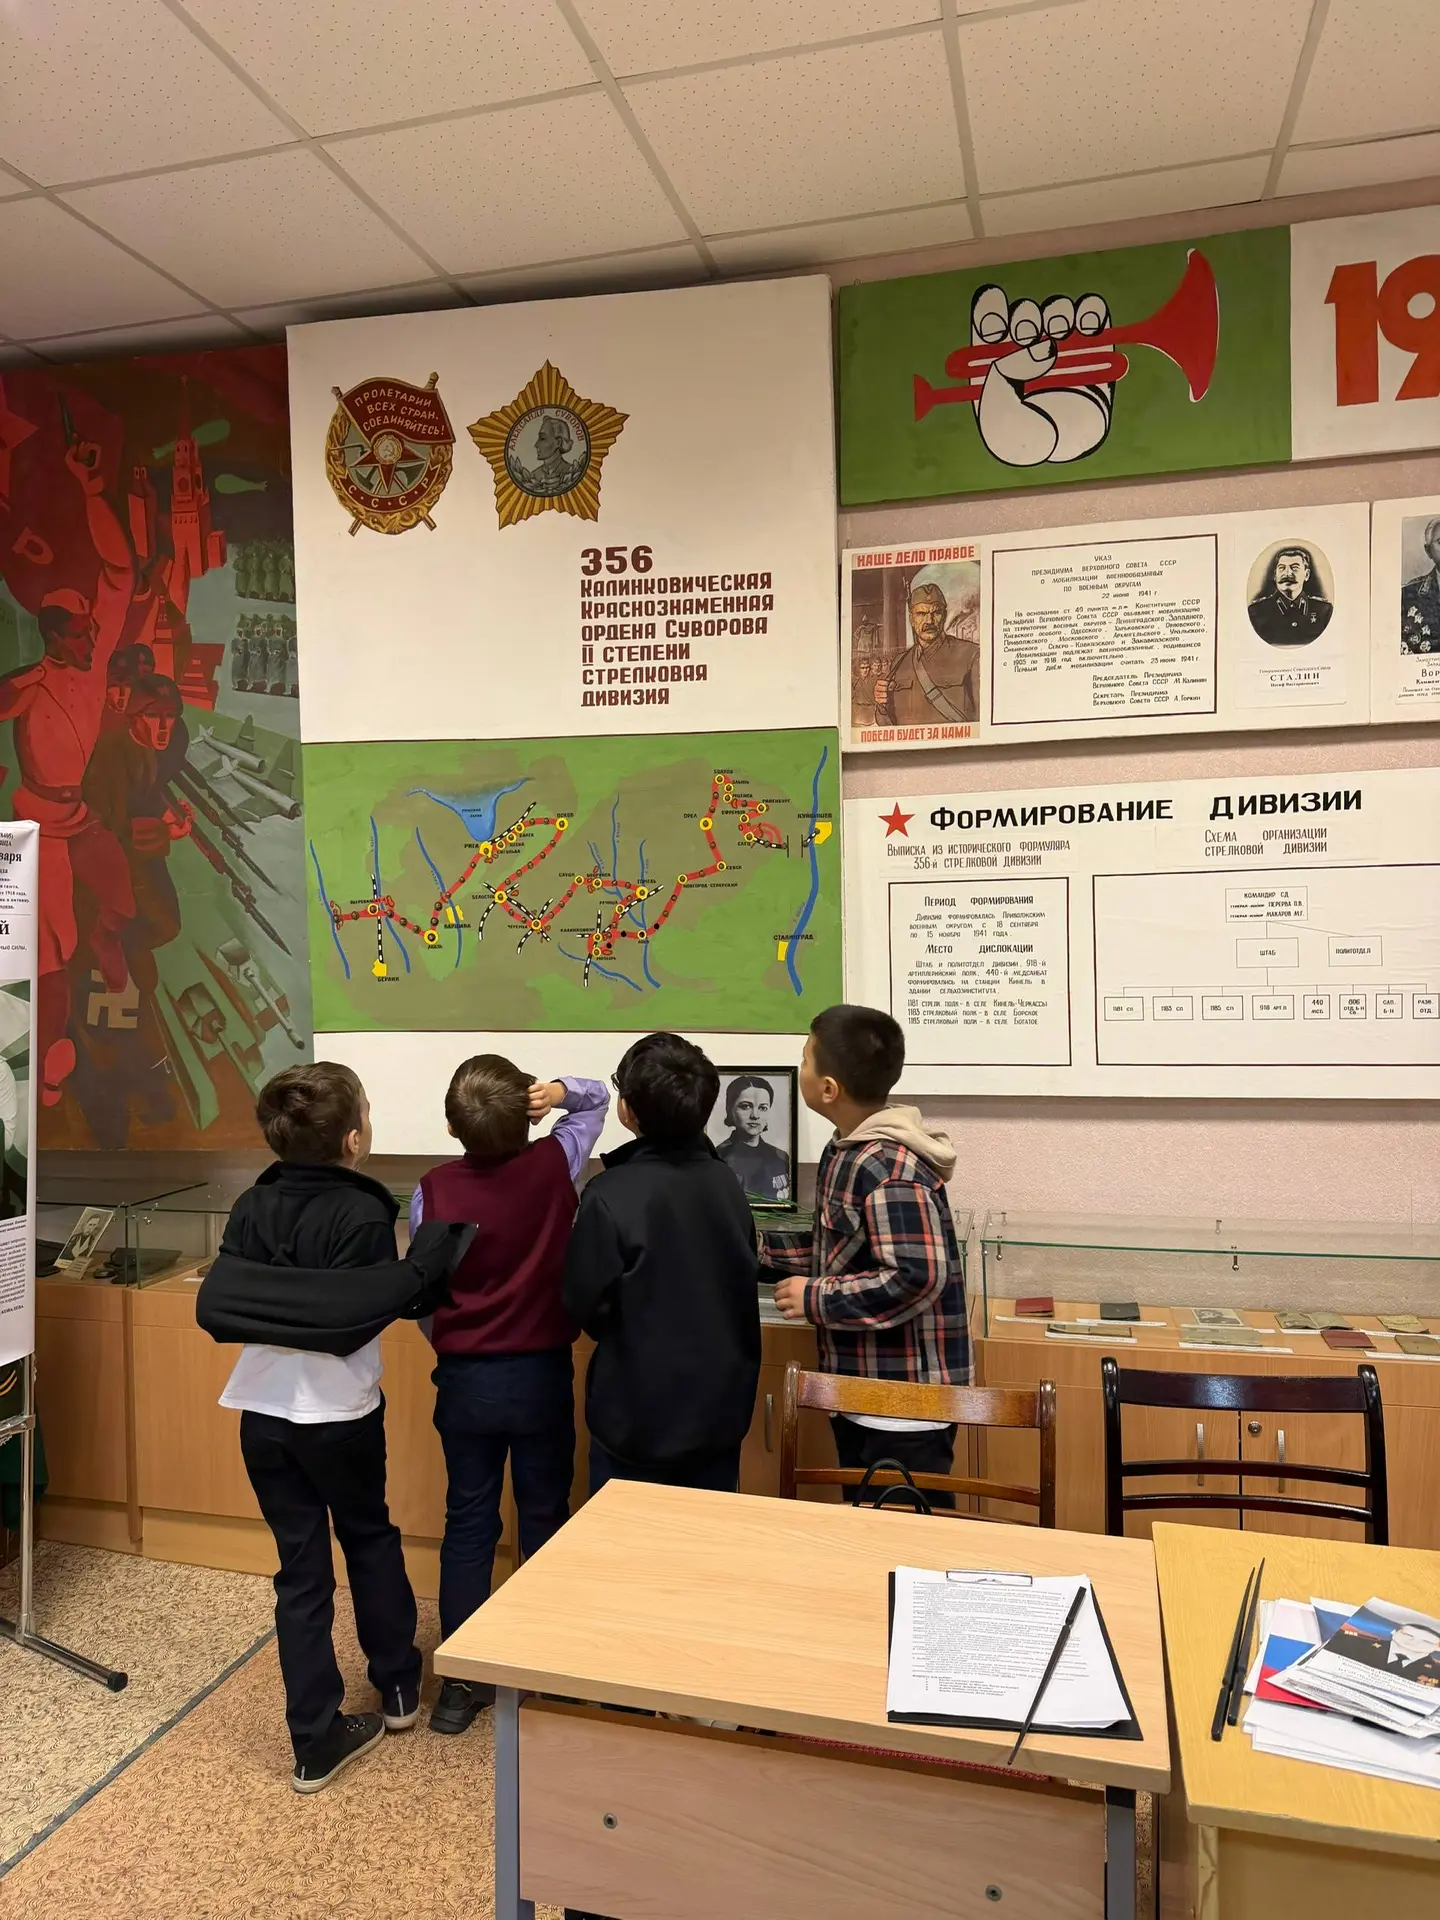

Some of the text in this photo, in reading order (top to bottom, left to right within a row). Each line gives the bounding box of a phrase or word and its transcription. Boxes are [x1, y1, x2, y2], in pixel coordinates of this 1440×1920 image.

[355, 388, 432, 407] ПРОЛЕТАРИИ
[366, 402, 396, 414] ВСЕХ
[363, 415, 445, 435] СОЕДИНЯЙТЕСЬ!
[581, 545, 653, 576] 356
[858, 546, 974, 567] НАШЕ ДЕЛО ПРАВОЕ
[1082, 564, 1120, 572] ВЕРХОВНОГО
[580, 572, 772, 598] КАЛИНКОВИЧЕСКАЯ
[581, 594, 774, 619] КРАСНОЗНАМЕННАЯ
[582, 616, 768, 641] ОРДЕНА СУВОРОВА
[602, 643, 690, 663] СТЕПЕНИ
[582, 664, 707, 685] СТРЕЛКОВАЯ
[1270, 672, 1320, 682] СТАЛИН
[581, 688, 670, 707] ДИВИЗИЯ
[860, 726, 971, 742] ПОБЕДА БУДЕТ ЗА НАМИ
[930, 790, 1362, 830] ФОРМИРОВАНИЕ ДИВИЗИИ
[1262, 828, 1328, 841] ОРГАНИЗАЦИИ
[1205, 842, 1328, 856] СТРЕЛКОВОЙ ДИВИЗИИ
[927, 930, 934, 938] 15
